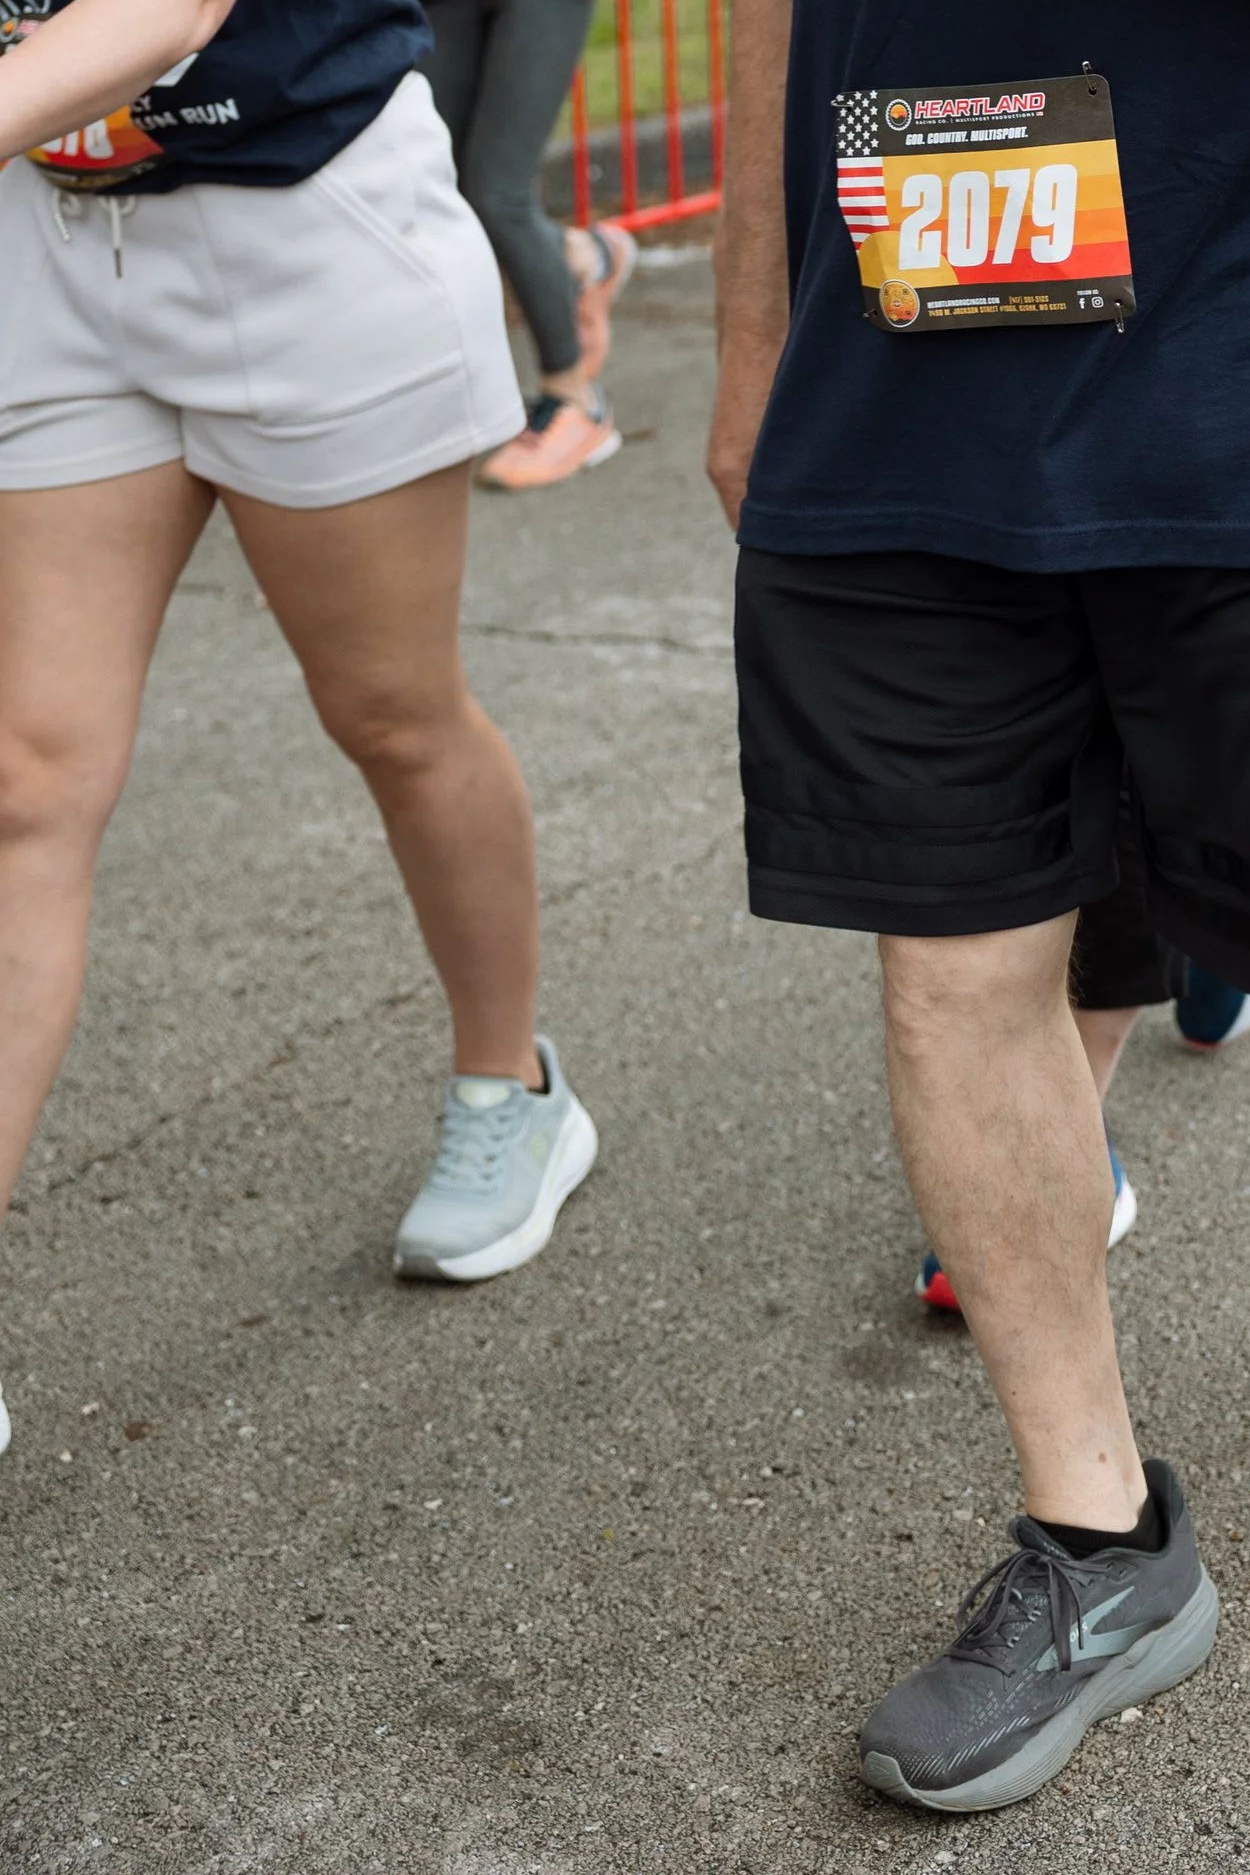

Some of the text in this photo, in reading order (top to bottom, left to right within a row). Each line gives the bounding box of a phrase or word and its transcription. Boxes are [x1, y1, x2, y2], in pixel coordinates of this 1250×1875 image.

[180, 98, 240, 125] RUN
[914, 92, 1046, 119] HEARTLAND
[991, 113, 1035, 121] PRODUCTIONS
[905, 126, 1028, 146] GOD. COUNTRY. MULTISPORT.
[898, 164, 1078, 271] 2079
